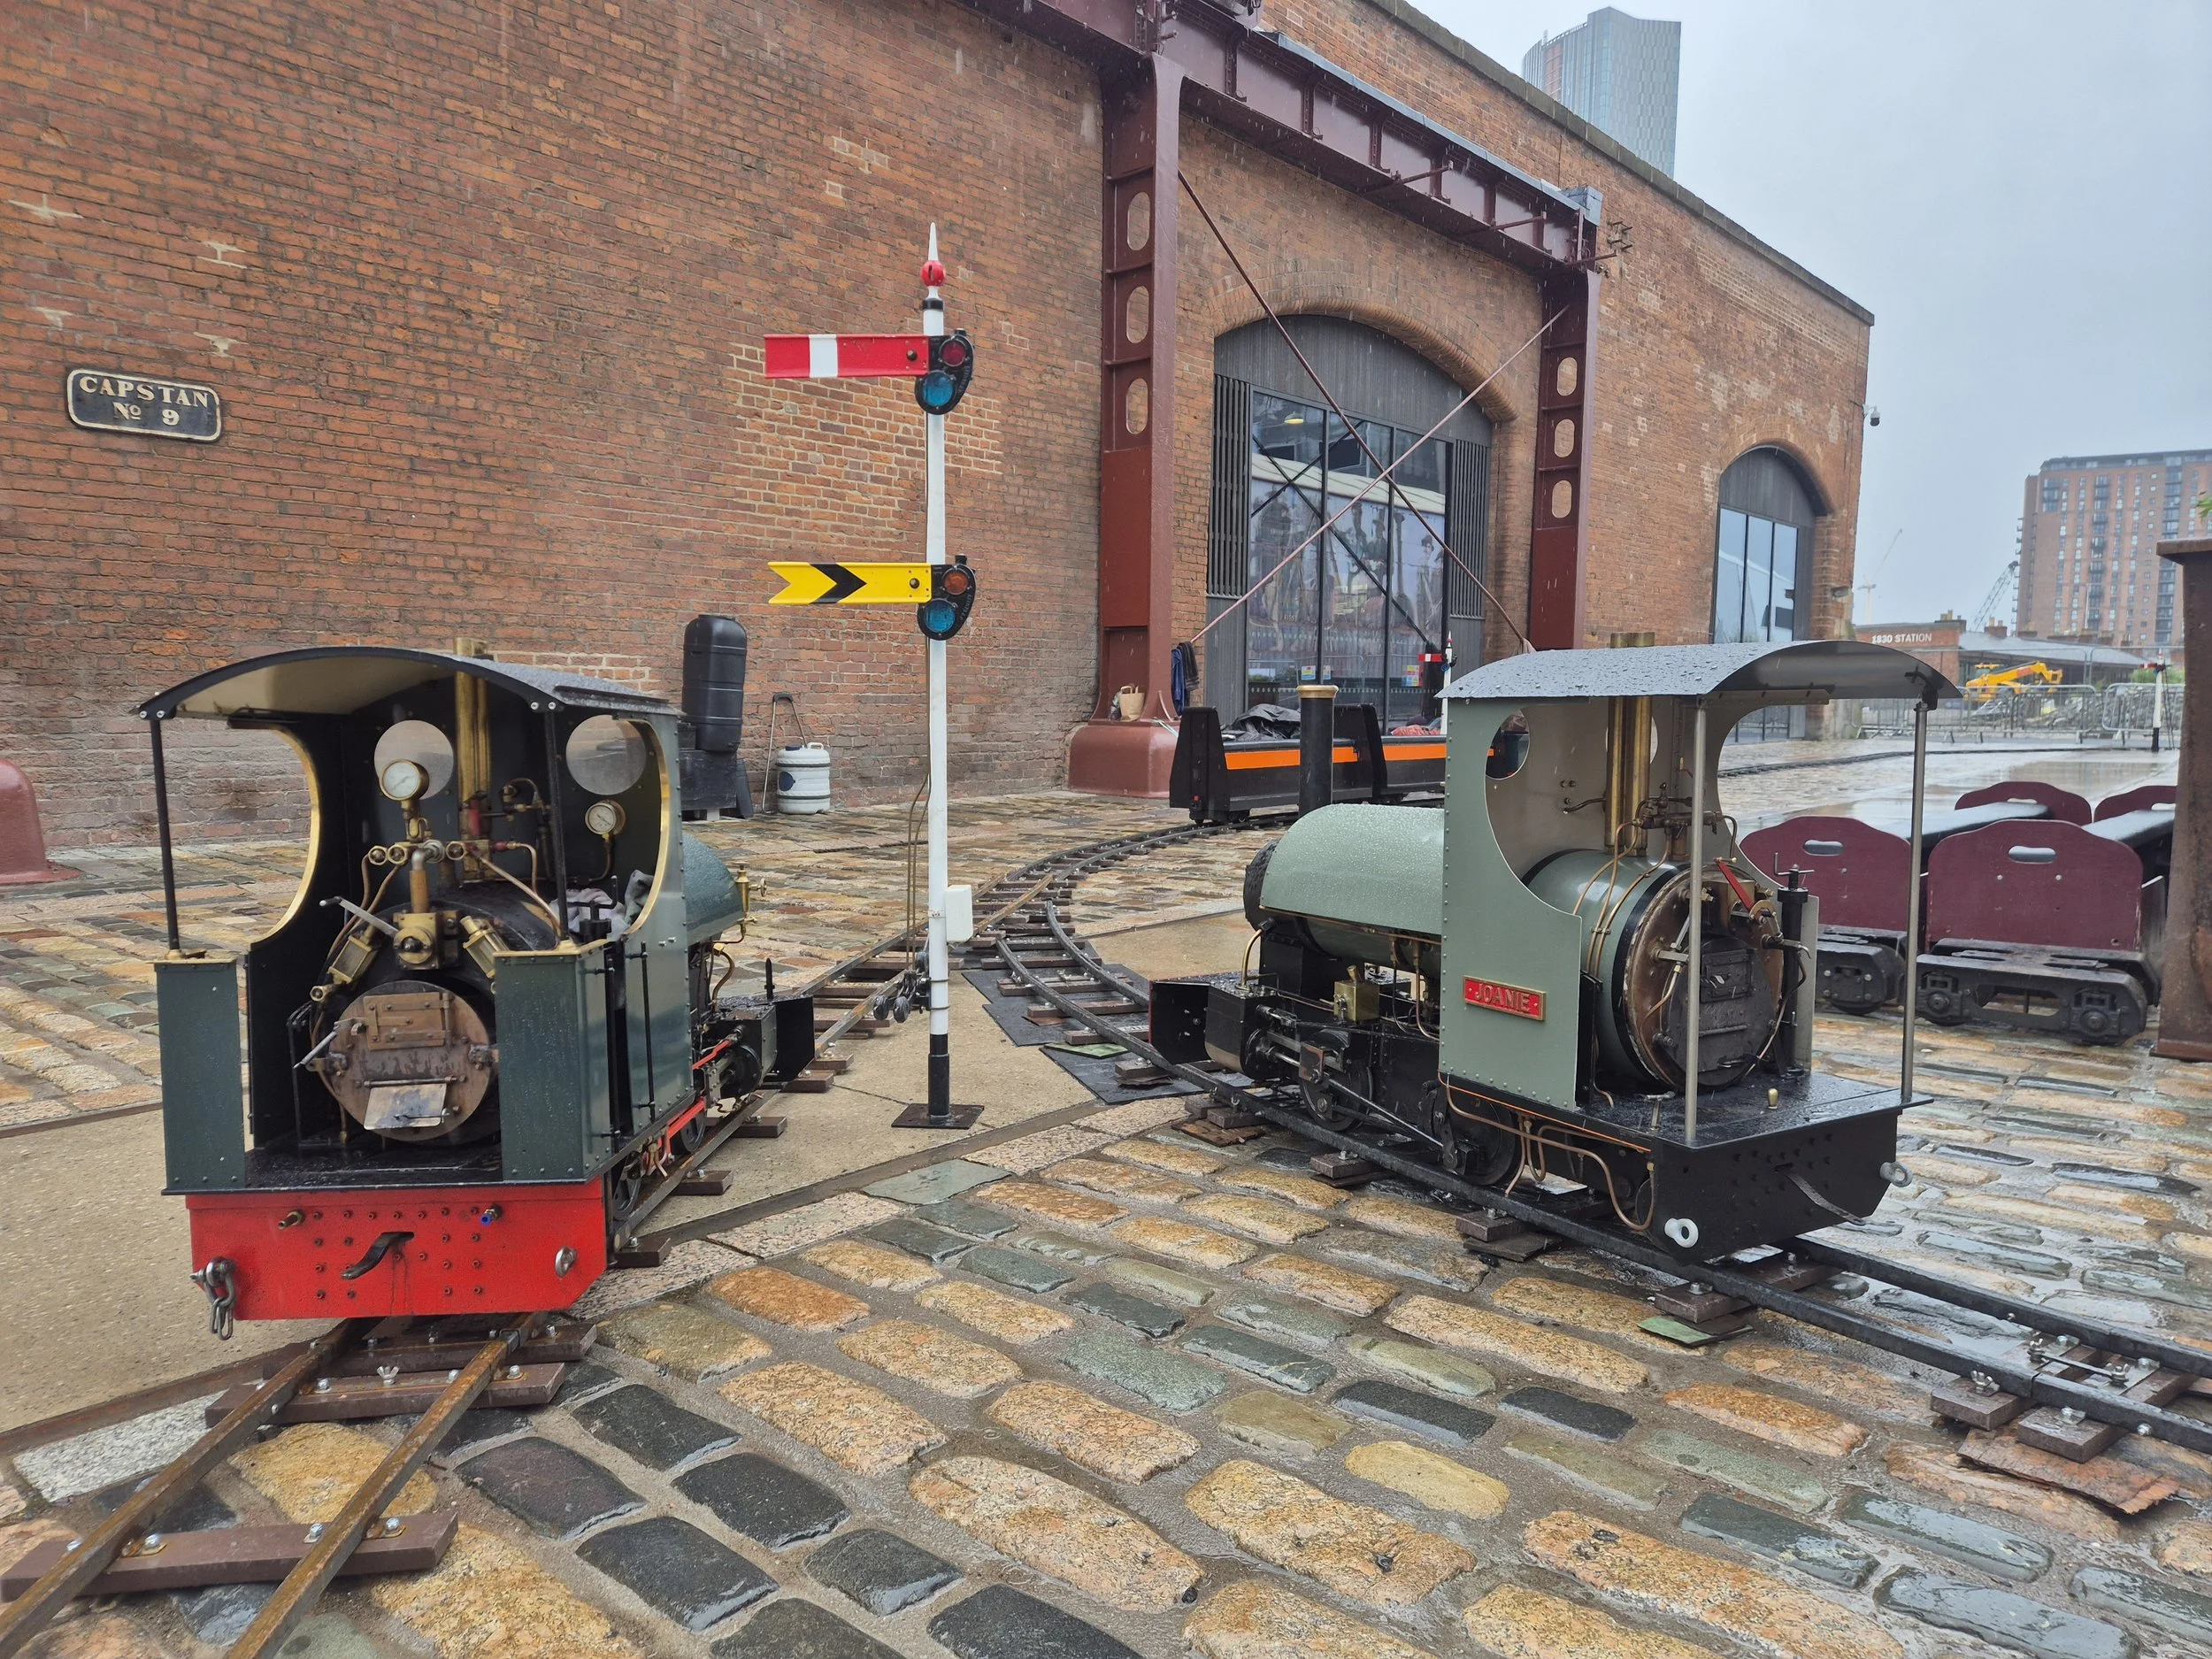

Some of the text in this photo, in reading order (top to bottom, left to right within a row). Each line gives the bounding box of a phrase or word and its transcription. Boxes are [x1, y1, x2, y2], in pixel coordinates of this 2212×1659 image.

[79, 376, 209, 408] CAPSTAN
[162, 409, 180, 426] 9
[1894, 633, 1932, 643] STATION
